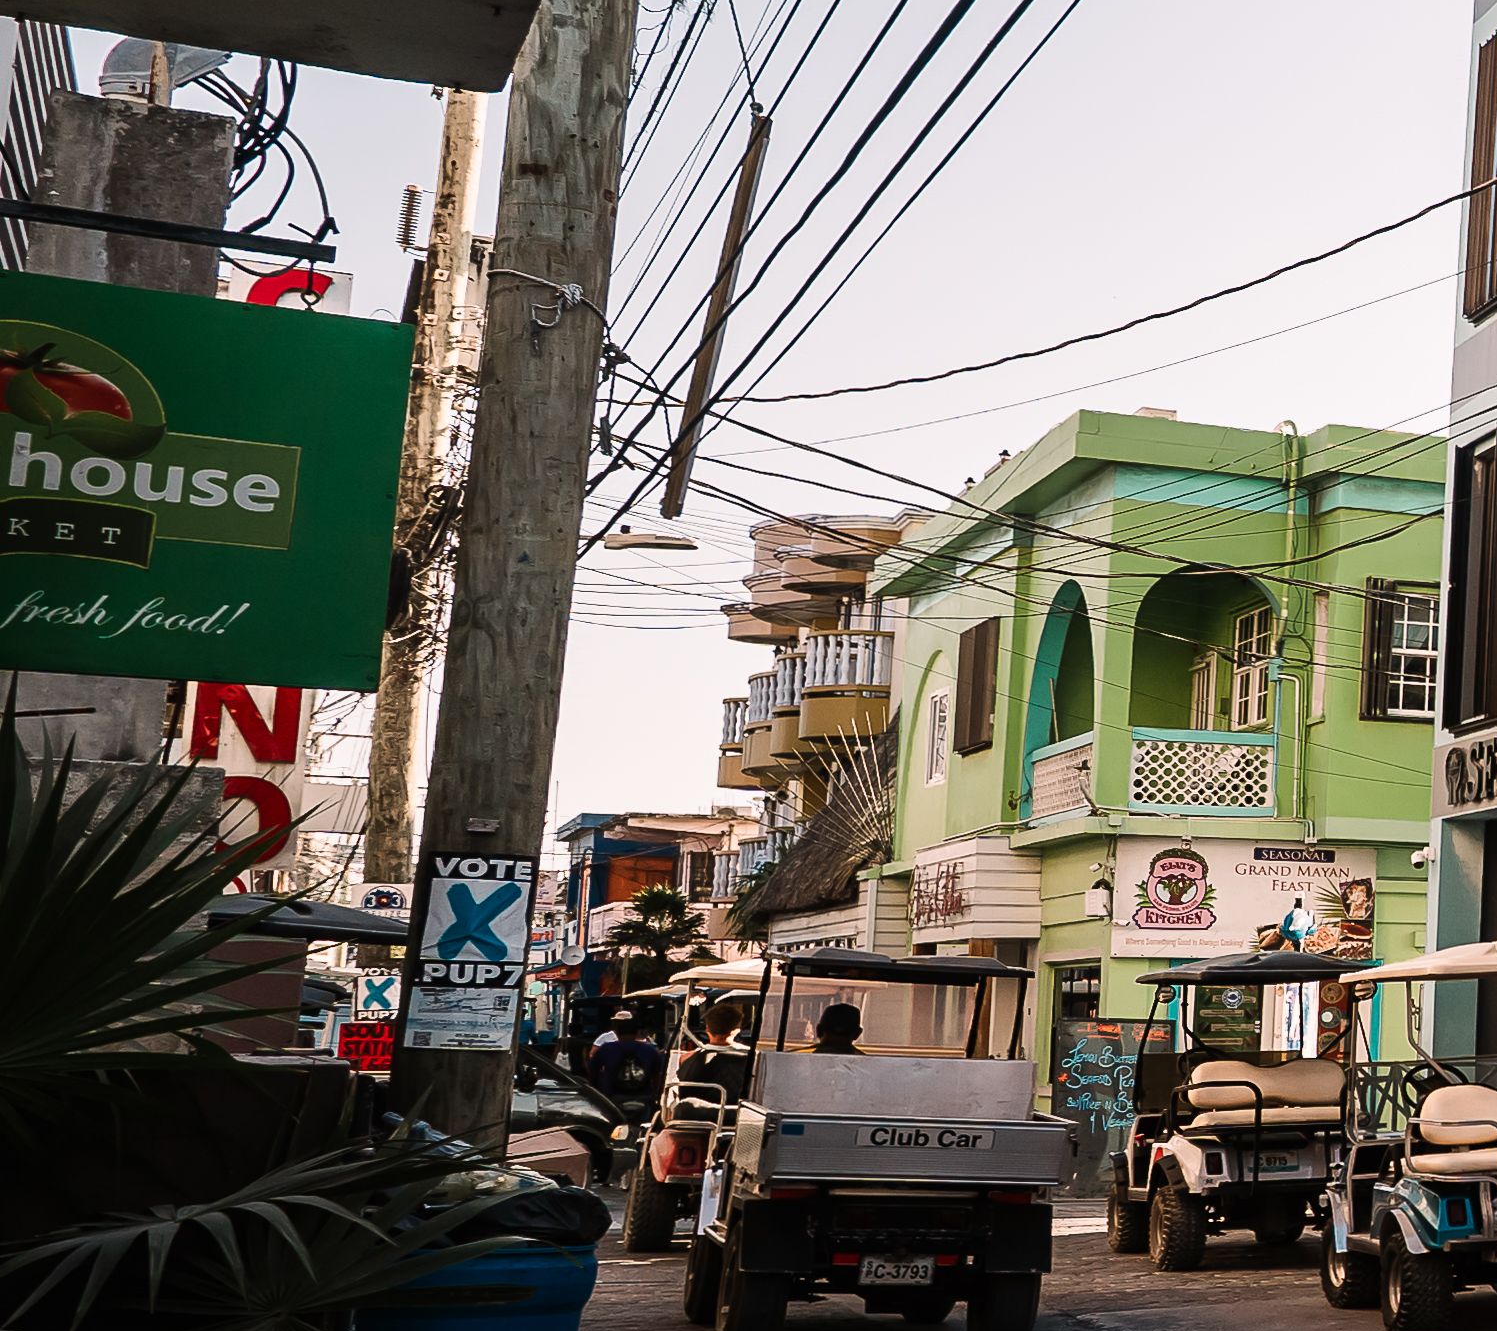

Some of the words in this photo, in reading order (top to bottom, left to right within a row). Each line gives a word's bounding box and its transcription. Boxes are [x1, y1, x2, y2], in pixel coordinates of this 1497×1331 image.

[9, 431, 281, 512] house
[8, 518, 121, 545] KET
[99, 596, 250, 639] food!
[1261, 849, 1328, 862] SEASONAL
[435, 857, 533, 880] VOTE
[1235, 863, 1292, 877] GRAND
[1297, 865, 1350, 878] MAYAN
[1272, 879, 1314, 892] FEAST
[1144, 910, 1203, 925] KITCHEN
[357, 1010, 399, 1020] PUP7
[870, 1127, 930, 1146] Club
[937, 1129, 983, 1148] Car
[873, 1264, 929, 1279] C-3793
